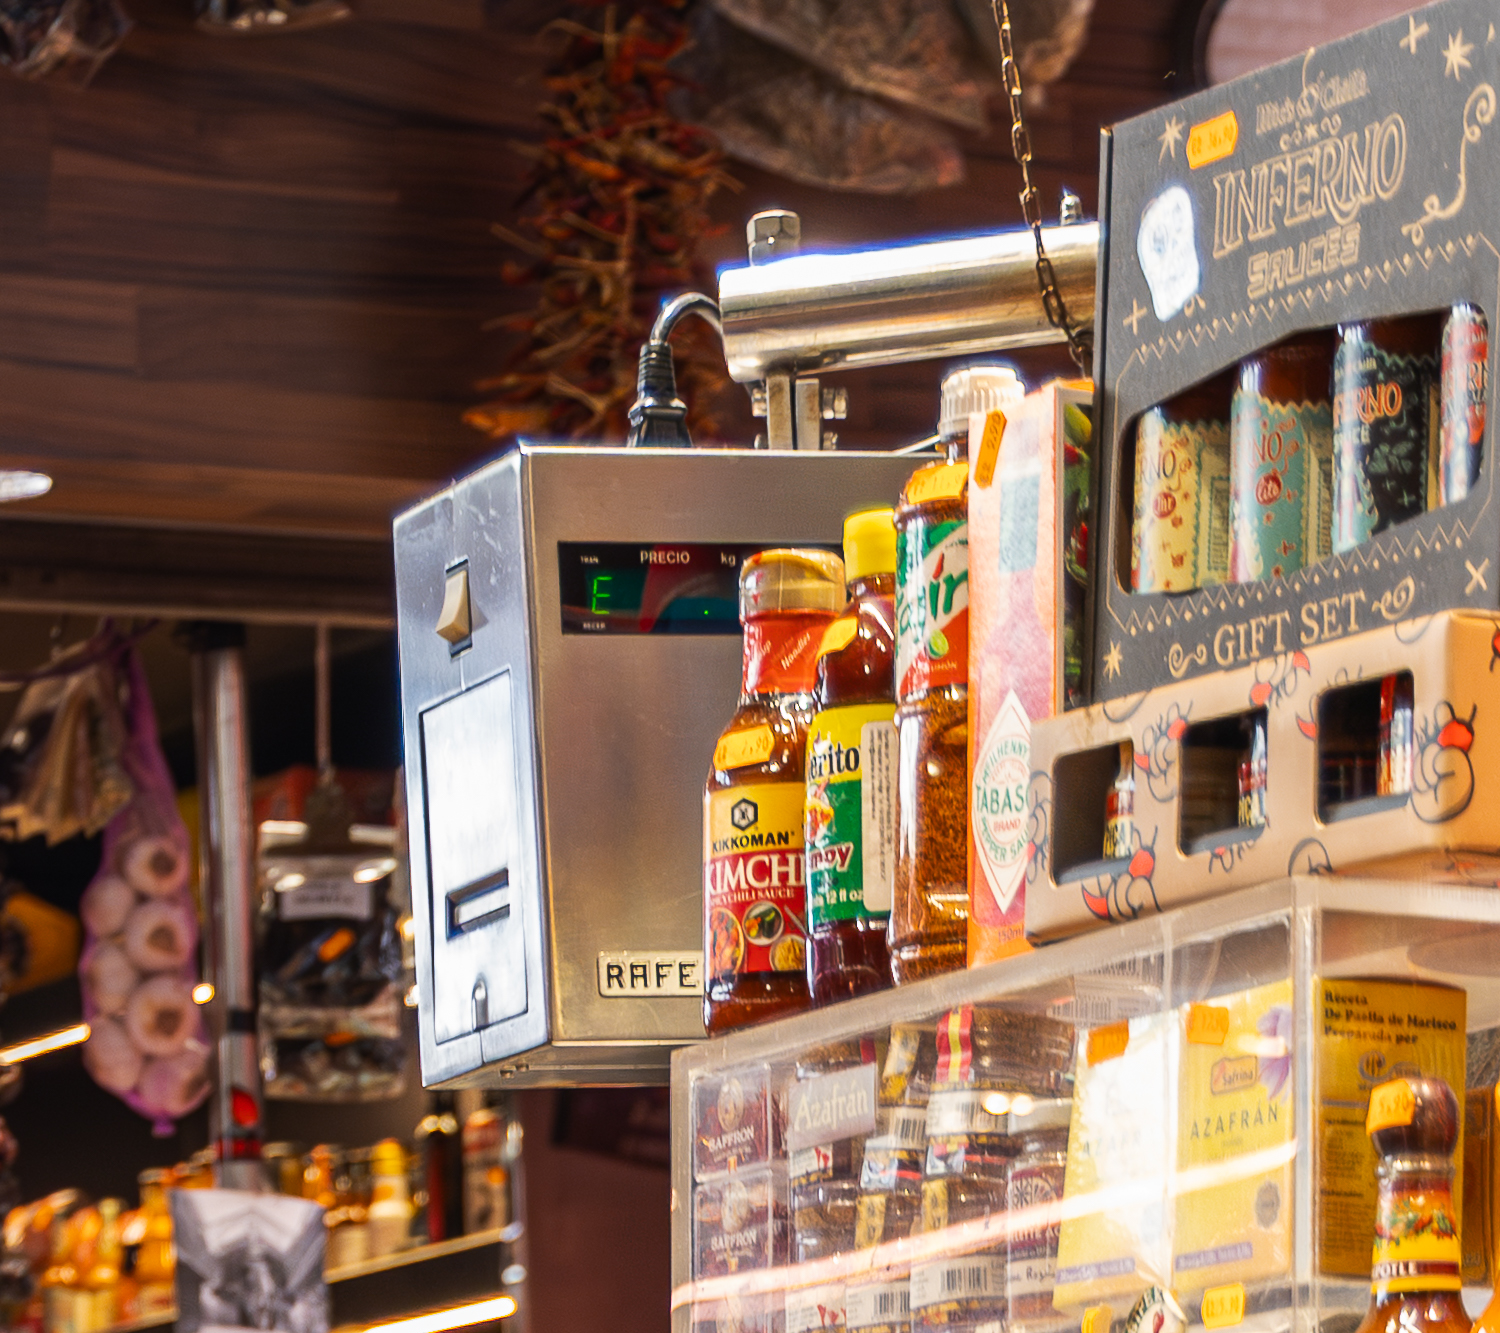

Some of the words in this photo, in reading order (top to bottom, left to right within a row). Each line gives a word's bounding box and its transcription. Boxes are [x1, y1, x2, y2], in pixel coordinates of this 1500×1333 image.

[1212, 112, 1404, 259] INFERNO
[1247, 223, 1361, 299] SAUCES
[640, 550, 690, 564] PRECIO
[721, 553, 736, 567] kg
[1213, 611, 1291, 665] GIFT
[1300, 592, 1366, 643] SET
[977, 783, 1029, 814] TABAS
[712, 831, 790, 853] KIKKOMAN
[1325, 990, 1368, 1006] Receta
[1325, 1008, 1340, 1022] De
[1343, 1009, 1387, 1025] Paella
[1390, 1012, 1403, 1026] de
[1407, 1014, 1457, 1032] Marisco
[1325, 1025, 1392, 1045] Preparada
[793, 1081, 869, 1132] Azafrán
[709, 1126, 755, 1151] SAFFRON
[711, 1230, 757, 1251] SAFFRON
[1373, 1261, 1418, 1279] POTLE
